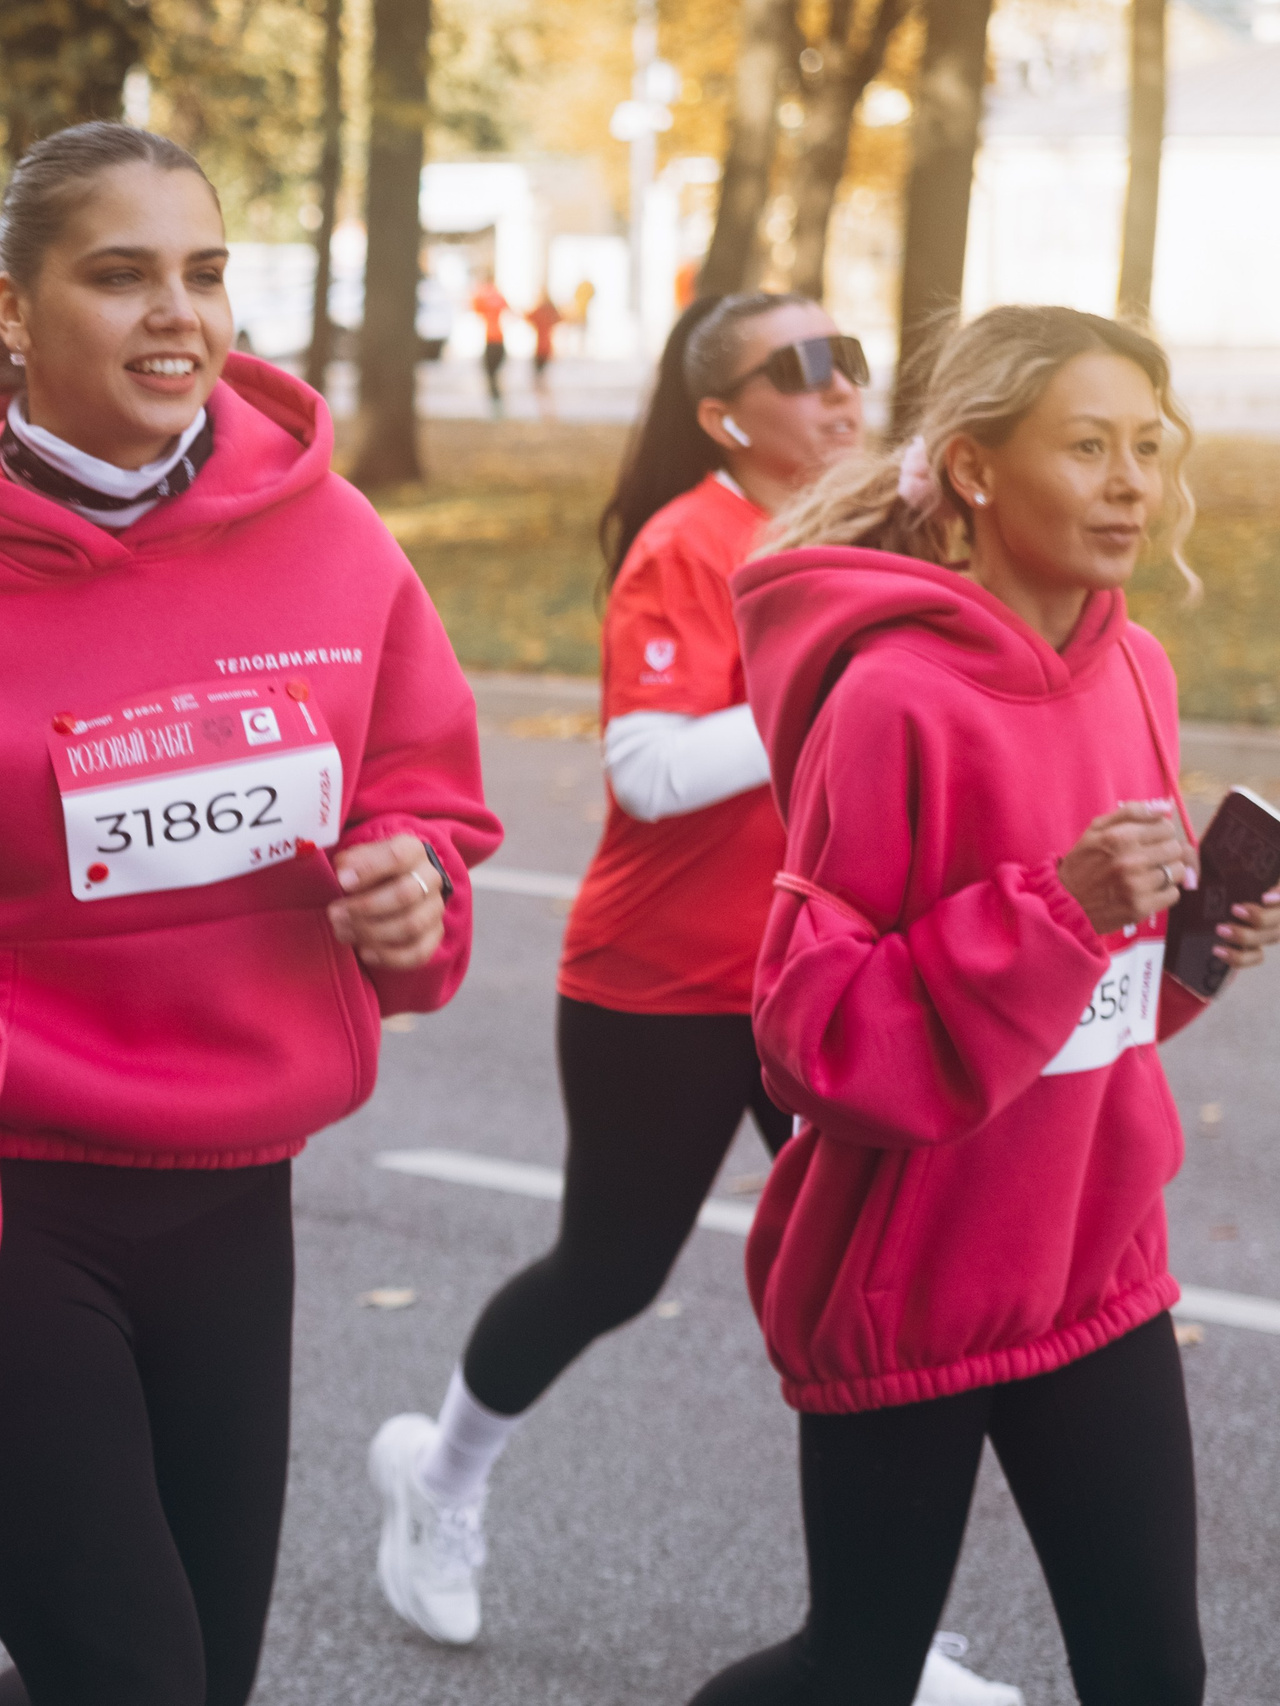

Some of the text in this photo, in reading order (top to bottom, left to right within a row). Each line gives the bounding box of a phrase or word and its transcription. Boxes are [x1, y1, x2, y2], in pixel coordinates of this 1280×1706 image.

[215, 647, 363, 675] ТЕЛОДВИЖЕНИЯ
[66, 721, 195, 777] РОЗОВЫЙ ЗАБЕГ
[95, 784, 282, 854] 31862
